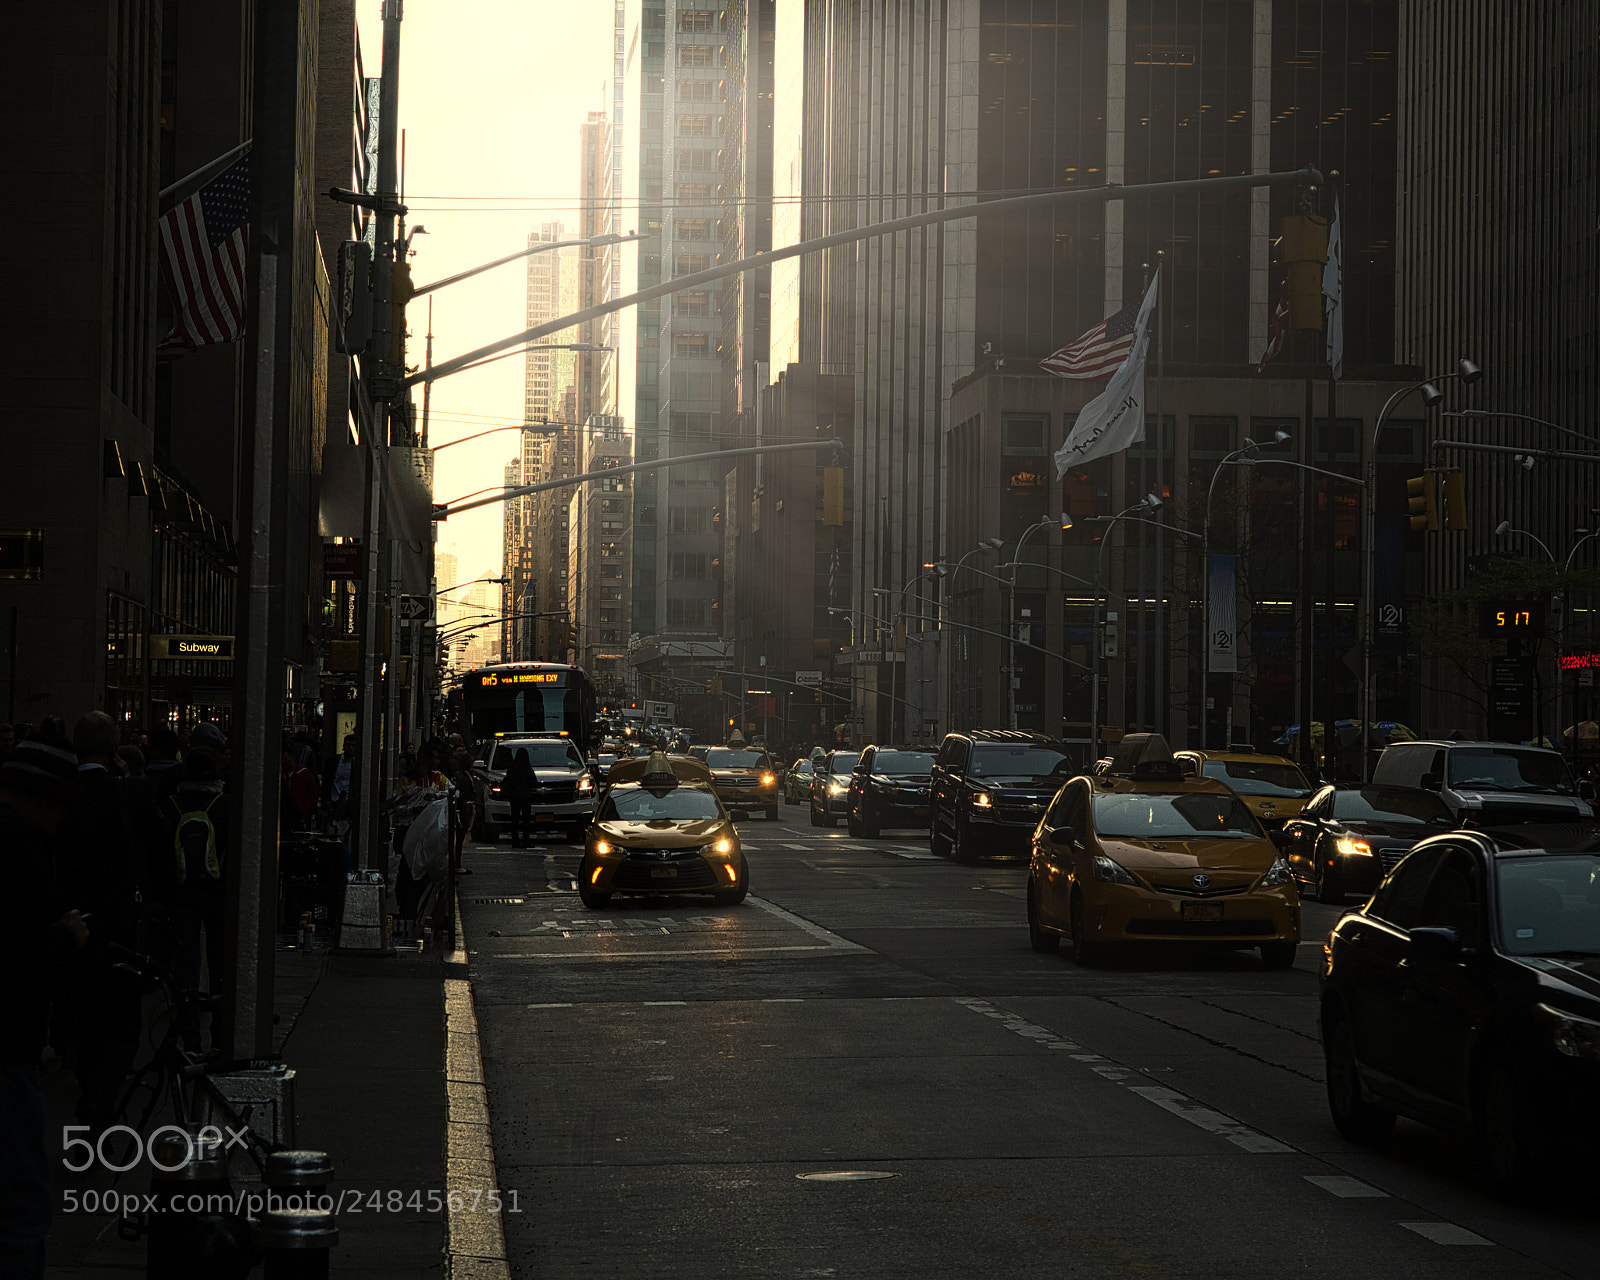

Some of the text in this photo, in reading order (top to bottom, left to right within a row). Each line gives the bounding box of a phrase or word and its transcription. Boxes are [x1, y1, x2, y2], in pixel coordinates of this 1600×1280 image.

[347, 594, 356, 634] McDonald's
[1378, 603, 1403, 627] 1221
[178, 641, 220, 655] Subway
[1212, 630, 1233, 649] 1221
